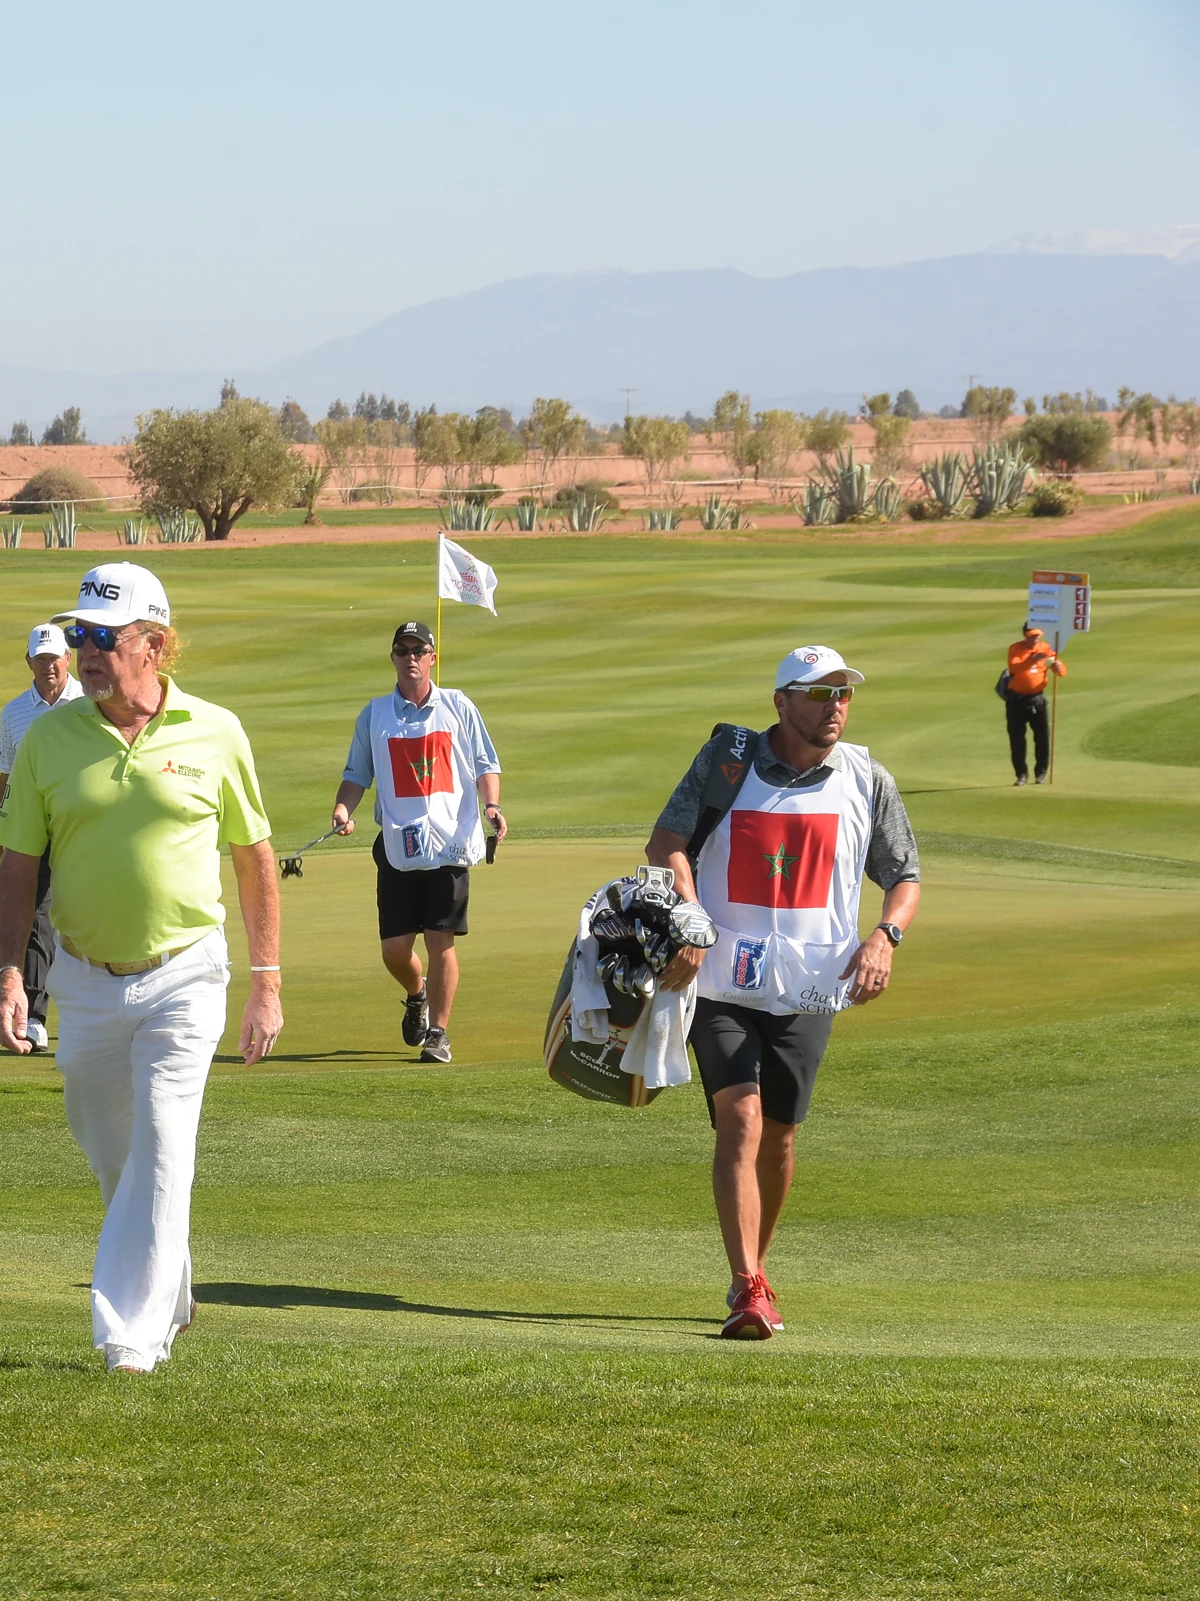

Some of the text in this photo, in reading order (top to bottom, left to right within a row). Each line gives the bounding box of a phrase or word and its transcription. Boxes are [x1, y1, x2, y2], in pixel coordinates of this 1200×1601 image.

[79, 581, 121, 601] PING
[1077, 589, 1085, 601] 1
[148, 604, 168, 619] PING
[1077, 603, 1085, 615] 1
[1075, 617, 1084, 629] 1
[740, 946, 756, 955] PGA
[736, 952, 750, 985] TOUR
[580, 1051, 611, 1070] SCOTT
